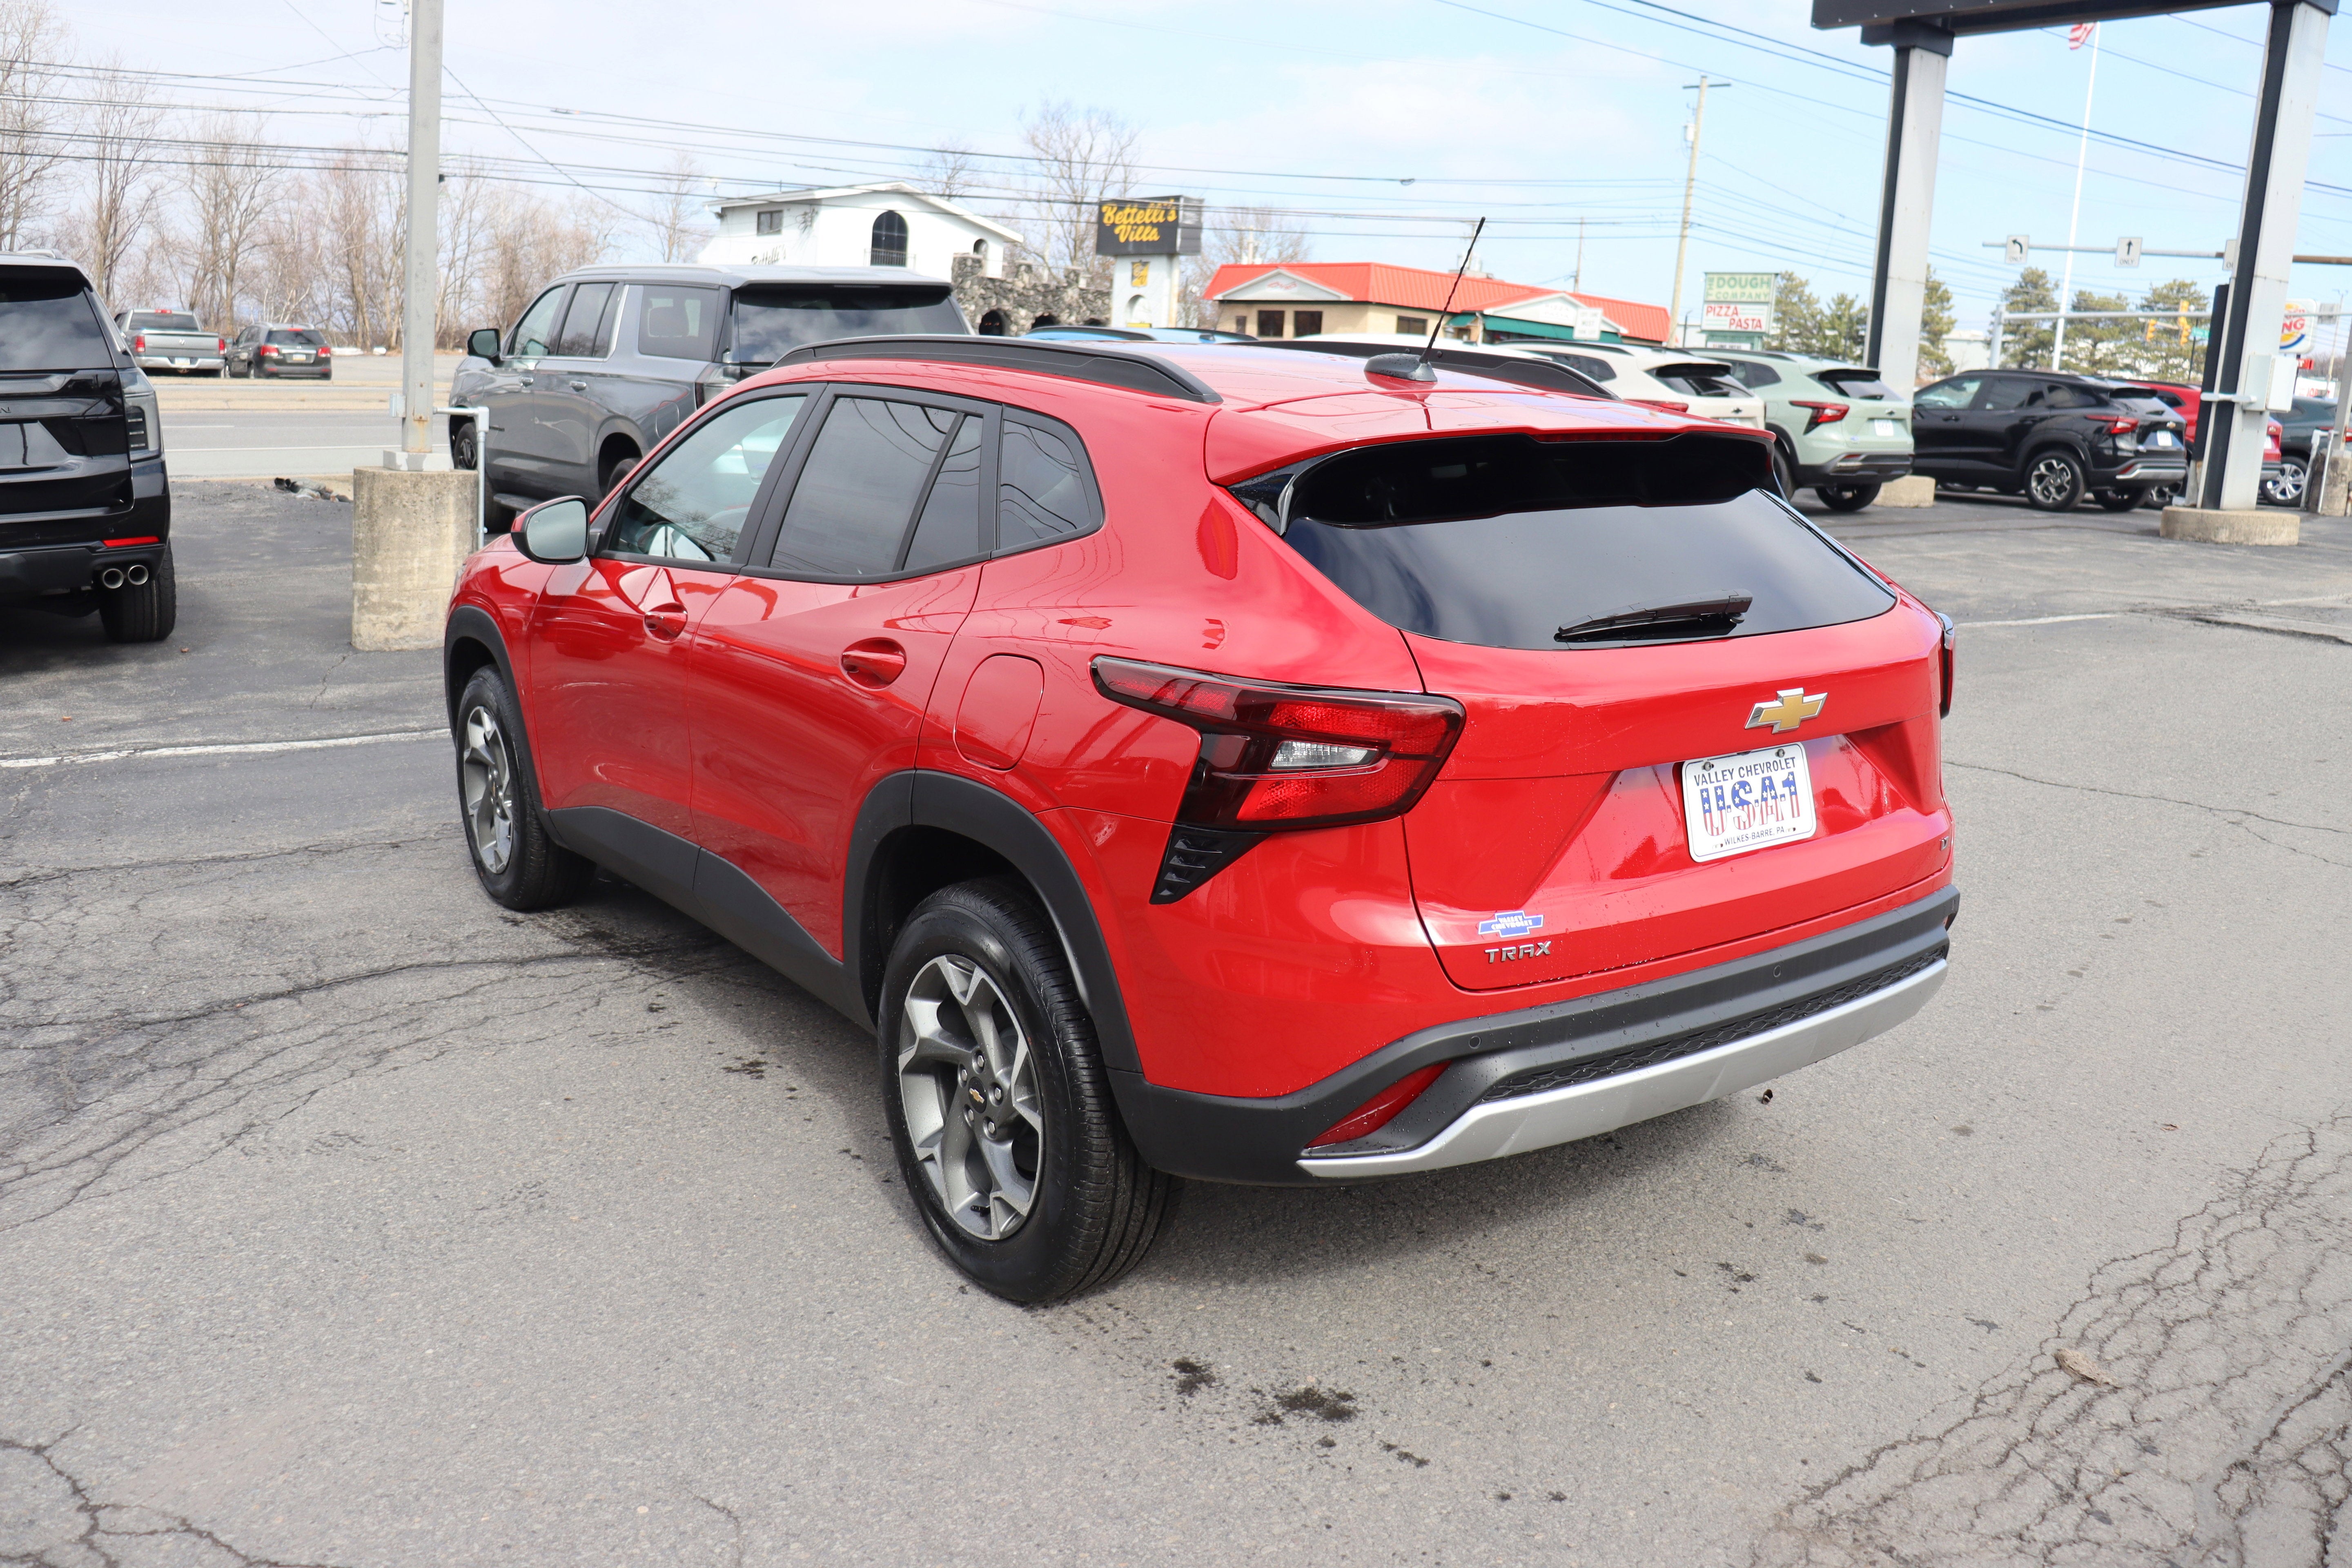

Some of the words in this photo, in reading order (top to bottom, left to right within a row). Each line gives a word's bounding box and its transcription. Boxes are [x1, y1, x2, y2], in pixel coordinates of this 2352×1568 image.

[1114, 225, 1160, 243] Villa
[1716, 276, 1770, 289] DOUGH
[1706, 305, 1739, 316] PIZZA
[1729, 318, 1762, 330] PASTA
[2281, 318, 2305, 334] NG
[1694, 768, 1734, 786] VALLEY
[1738, 757, 1795, 778] CHEVROLET
[1491, 920, 1533, 930] CHEVROLET
[1498, 915, 1523, 923] VALLEY
[1484, 941, 1552, 963] TRAX
